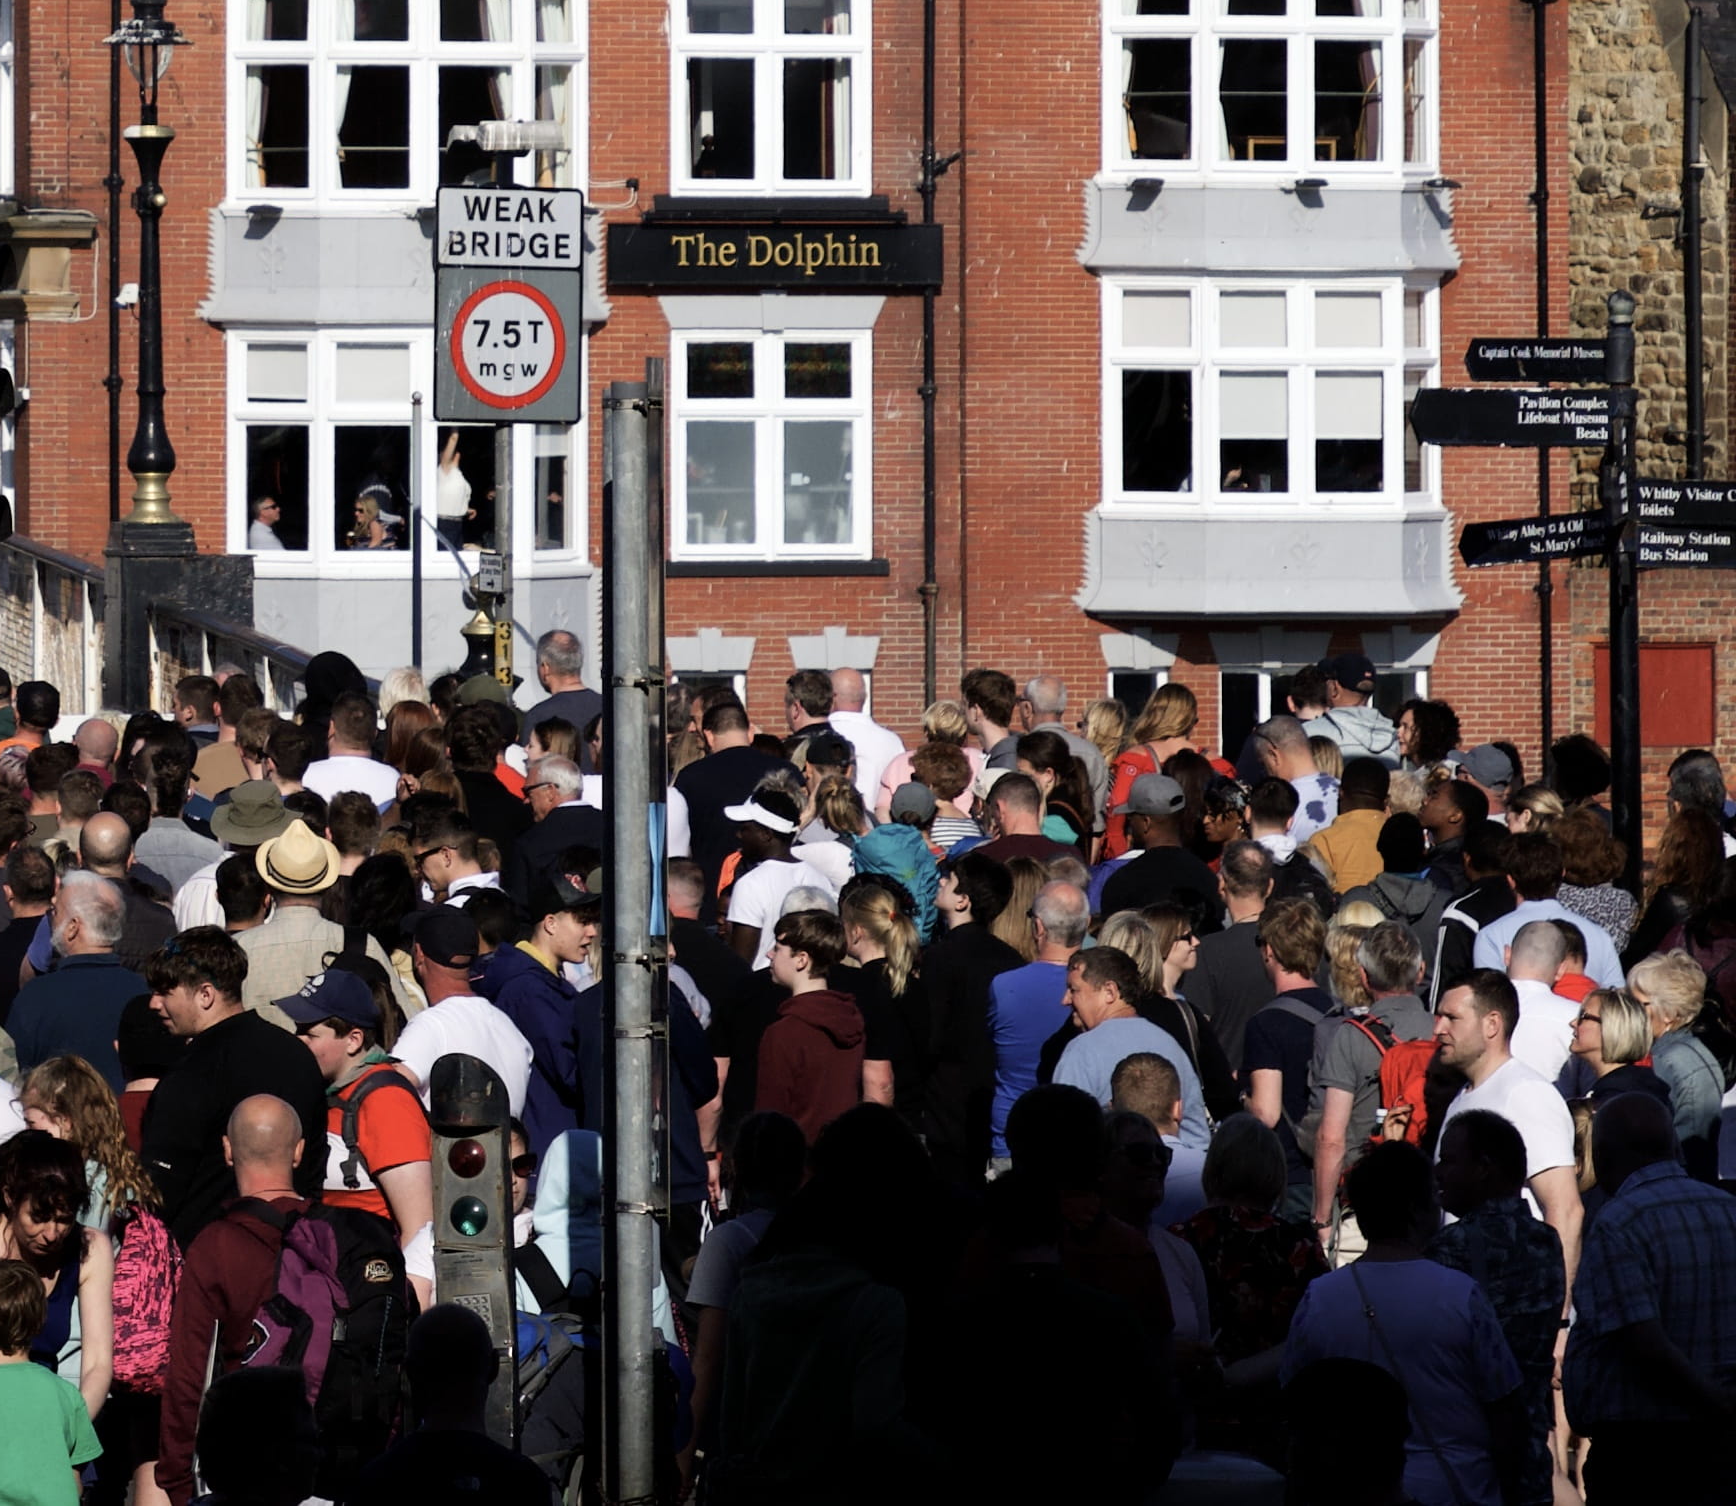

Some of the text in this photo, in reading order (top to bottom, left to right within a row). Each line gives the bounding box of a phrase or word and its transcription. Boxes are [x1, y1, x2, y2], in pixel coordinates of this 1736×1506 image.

[464, 196, 556, 223] WEAK
[449, 231, 570, 259] BRIDGE
[671, 232, 882, 276] The Dolphin
[1478, 345, 1605, 362] Captain Cook Memorial Museum
[1519, 395, 1609, 412] Pavilion Complex
[1517, 411, 1609, 425] Lifeboat Museum
[1576, 426, 1609, 440] Beach
[1639, 486, 1682, 503] Whitby
[1686, 487, 1724, 502] Visitor
[1637, 502, 1676, 517] Toilets
[1520, 523, 1547, 538] Abbey
[1558, 520, 1565, 533] &
[1566, 518, 1584, 532] Old
[1529, 541, 1544, 554] St.
[1545, 537, 1576, 552] Mary's
[1639, 531, 1732, 548] Railway Station
[1639, 547, 1710, 563] Bus Station
[499, 622, 512, 685] 313
